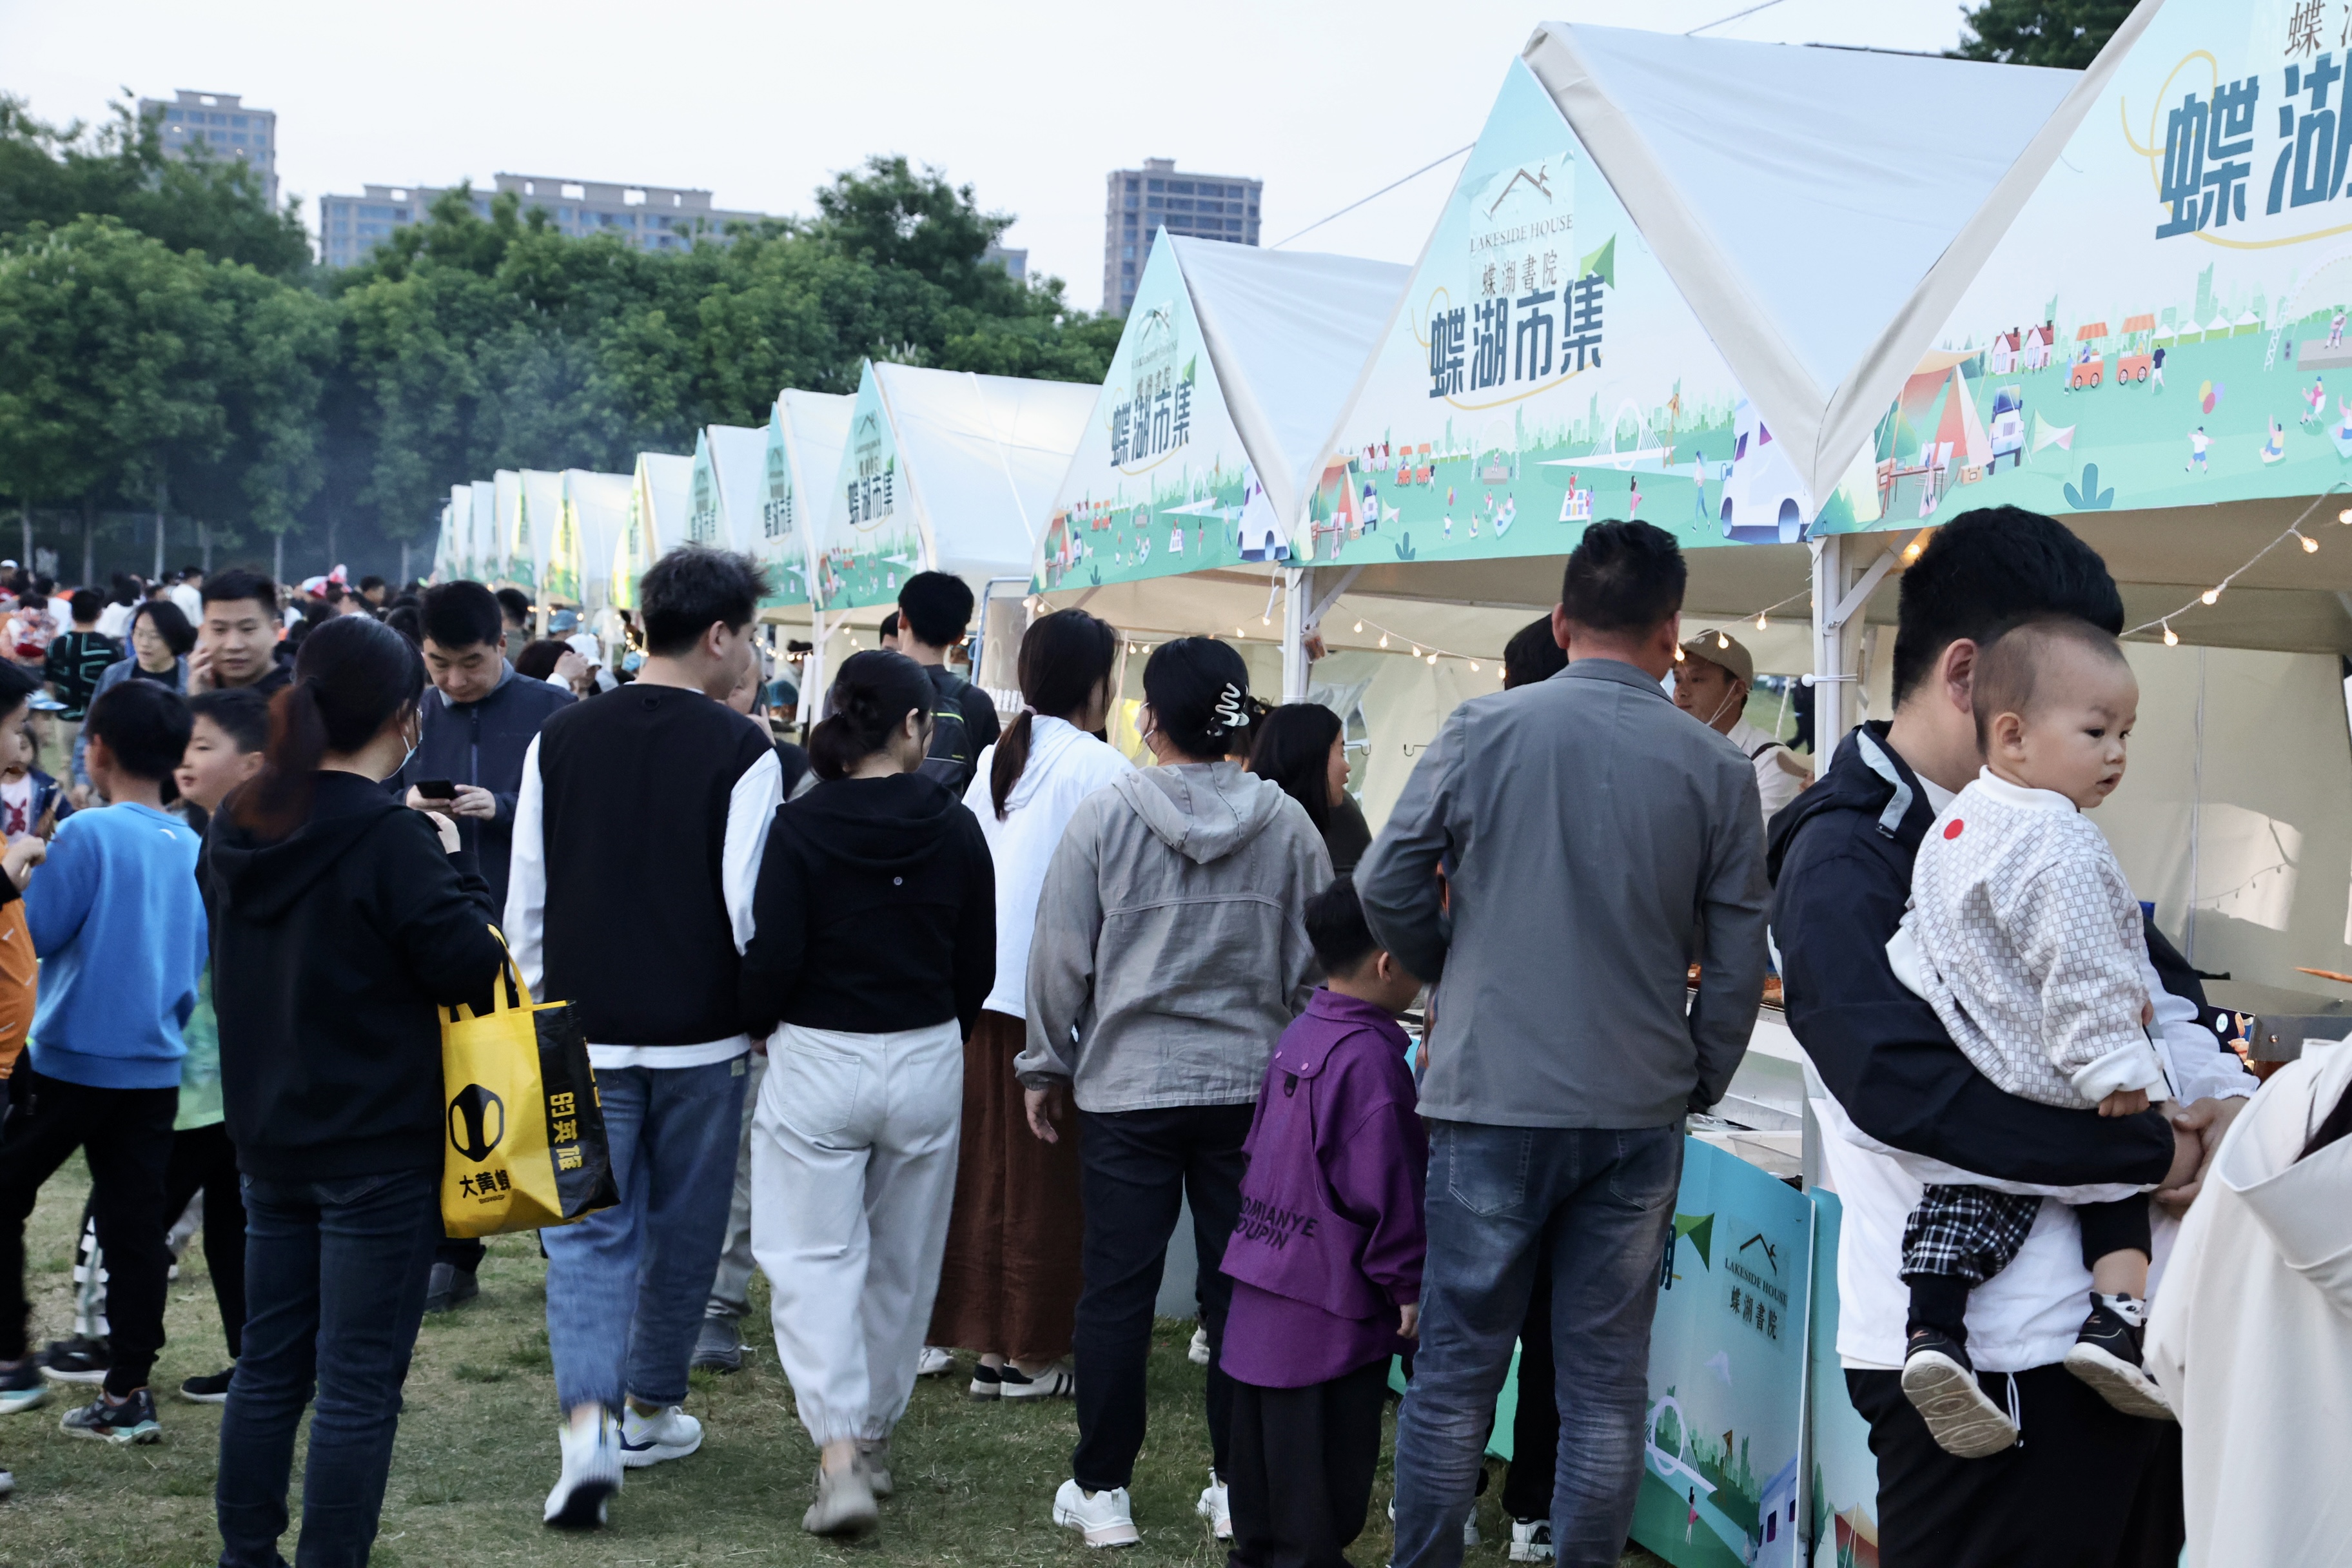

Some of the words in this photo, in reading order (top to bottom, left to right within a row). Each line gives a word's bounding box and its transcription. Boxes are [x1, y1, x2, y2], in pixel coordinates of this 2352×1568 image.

[1471, 226, 1527, 252] LAKESIDE
[1531, 214, 1574, 237] HOUSE
[1482, 249, 1558, 299] 蝶湖書院
[1429, 274, 1605, 398] 蝶湖市集
[1111, 379, 1191, 467] 蝶湖市集
[1725, 1258, 1761, 1289] LAKESIDE
[1762, 1280, 1787, 1308] HOUSE
[1730, 1285, 1778, 1340] 蝶湖書院
